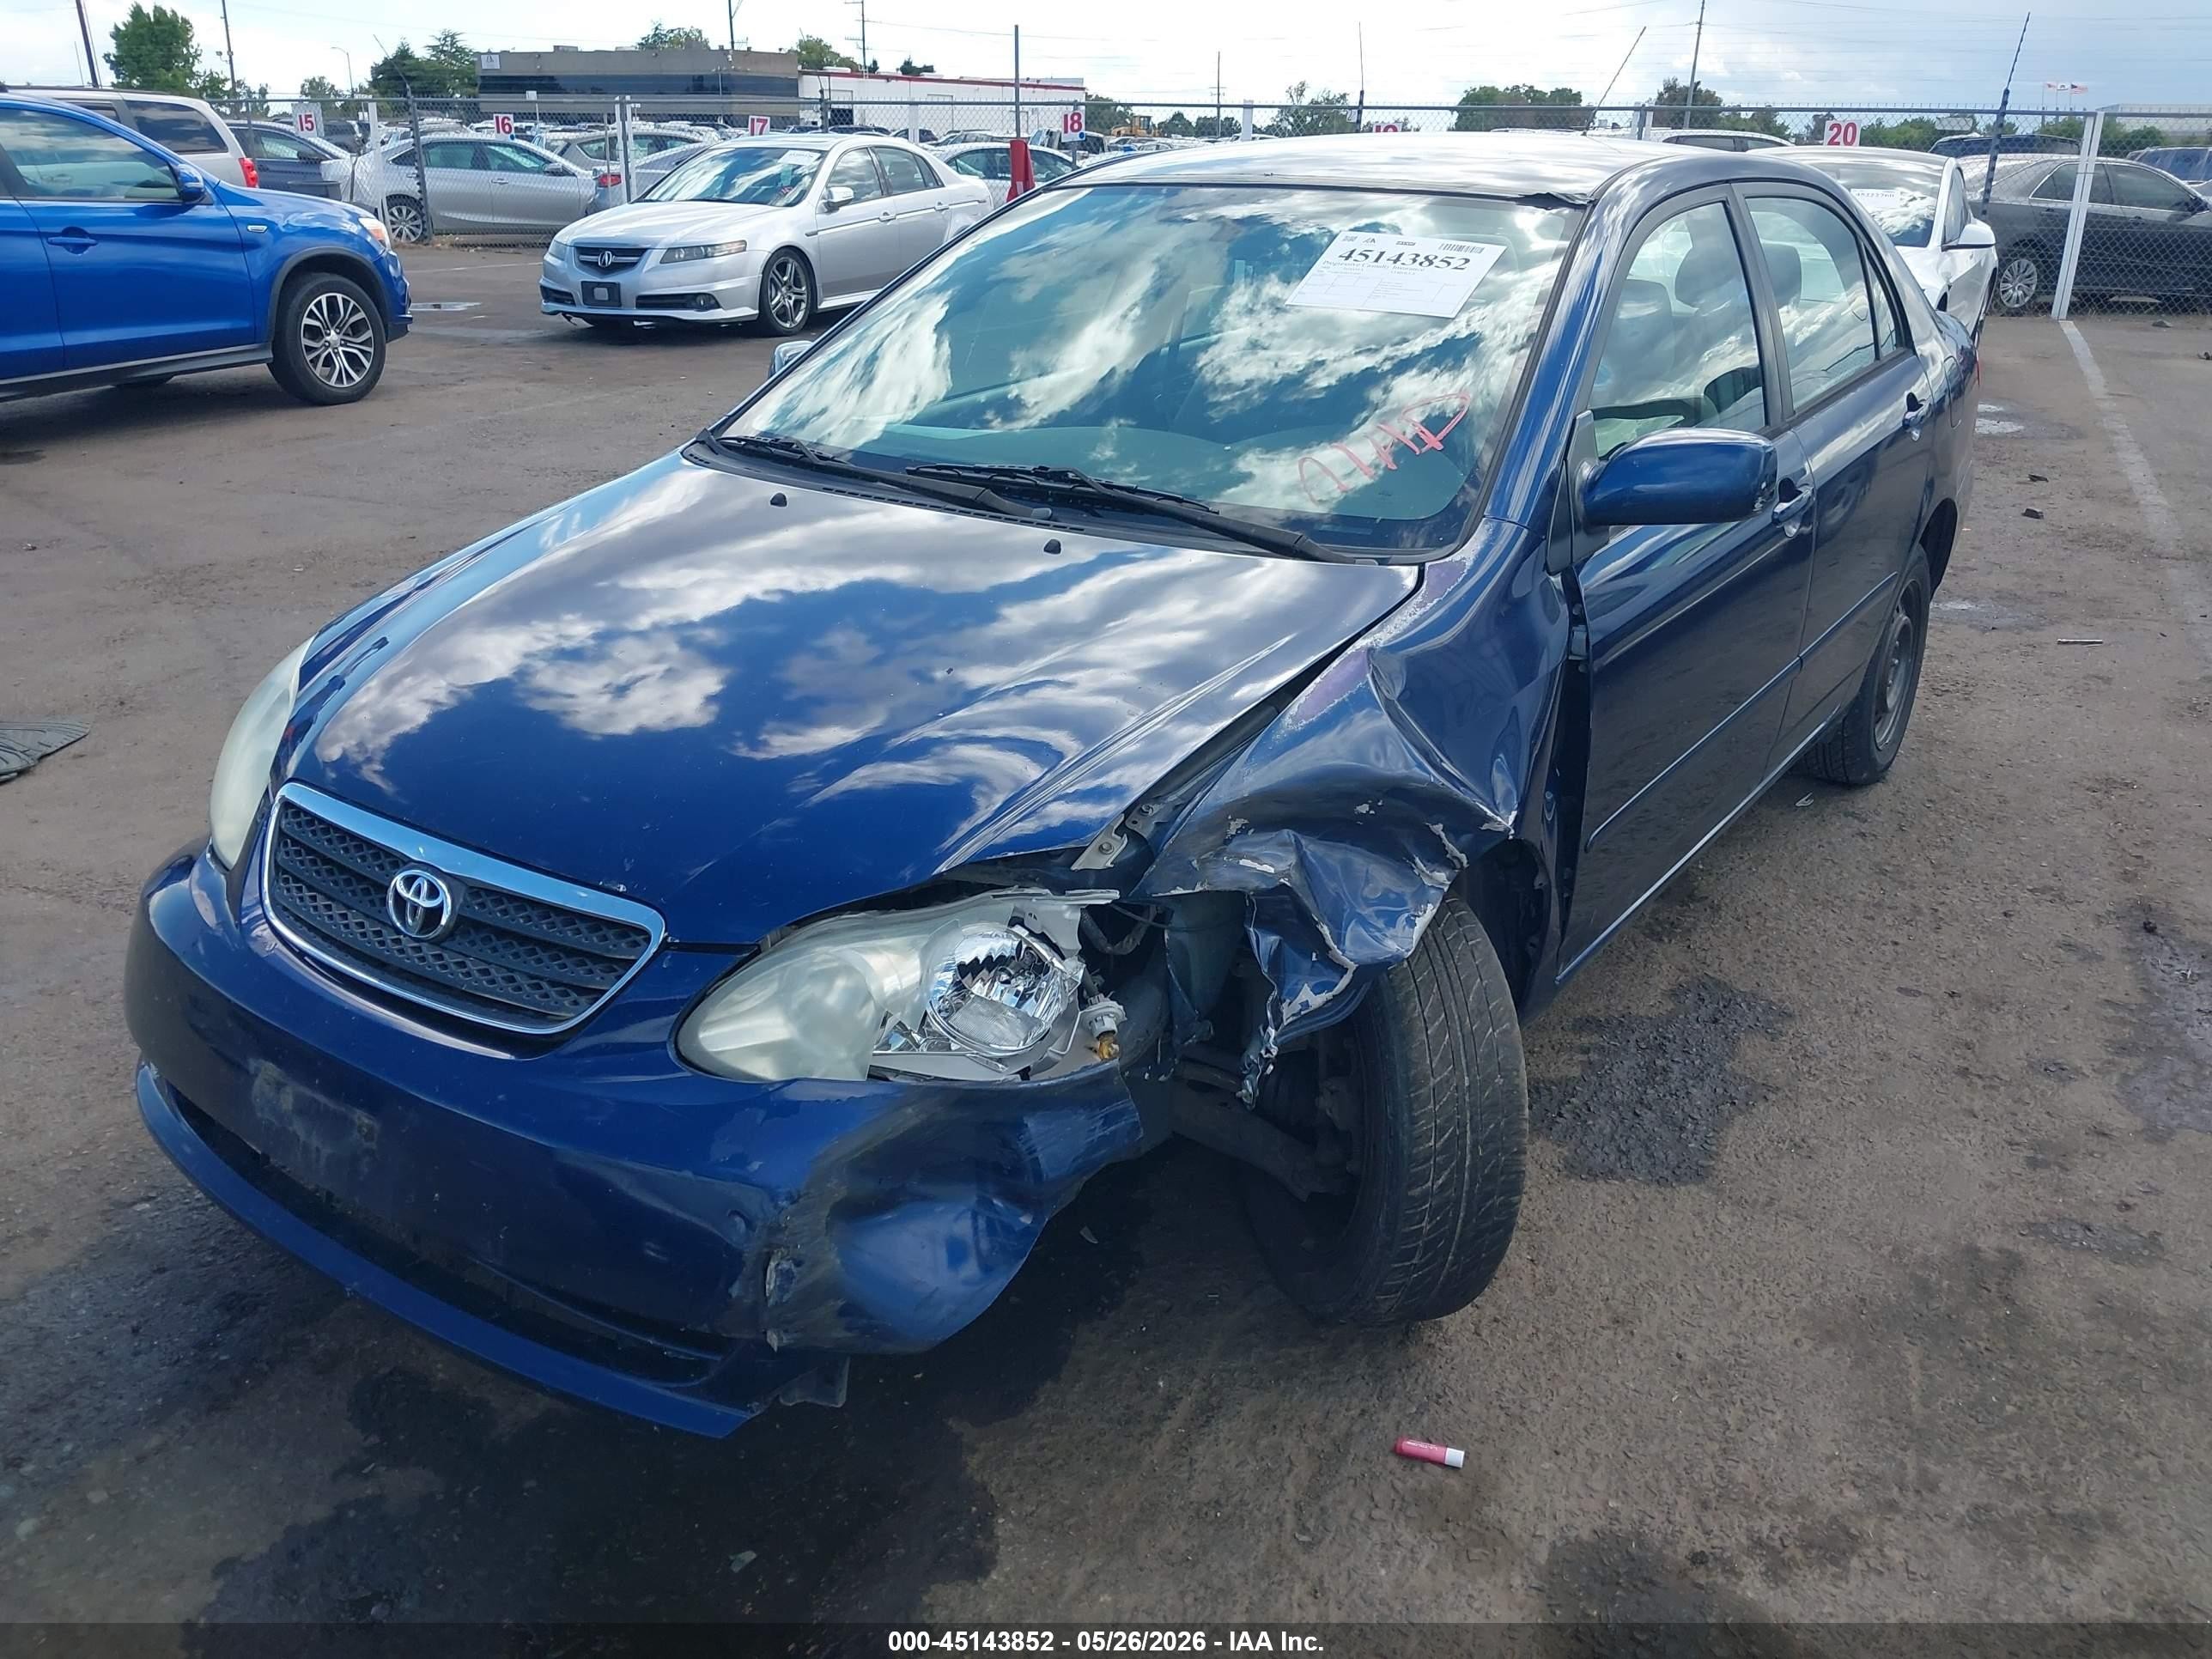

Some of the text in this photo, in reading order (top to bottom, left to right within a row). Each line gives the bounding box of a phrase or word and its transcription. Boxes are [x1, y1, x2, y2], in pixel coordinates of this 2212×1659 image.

[298, 113, 315, 131] 15
[495, 115, 513, 135] 16
[750, 117, 769, 137] 17
[1063, 112, 1083, 134] 18
[1827, 122, 1856, 146] 20
[1337, 247, 1471, 270] 45143852
